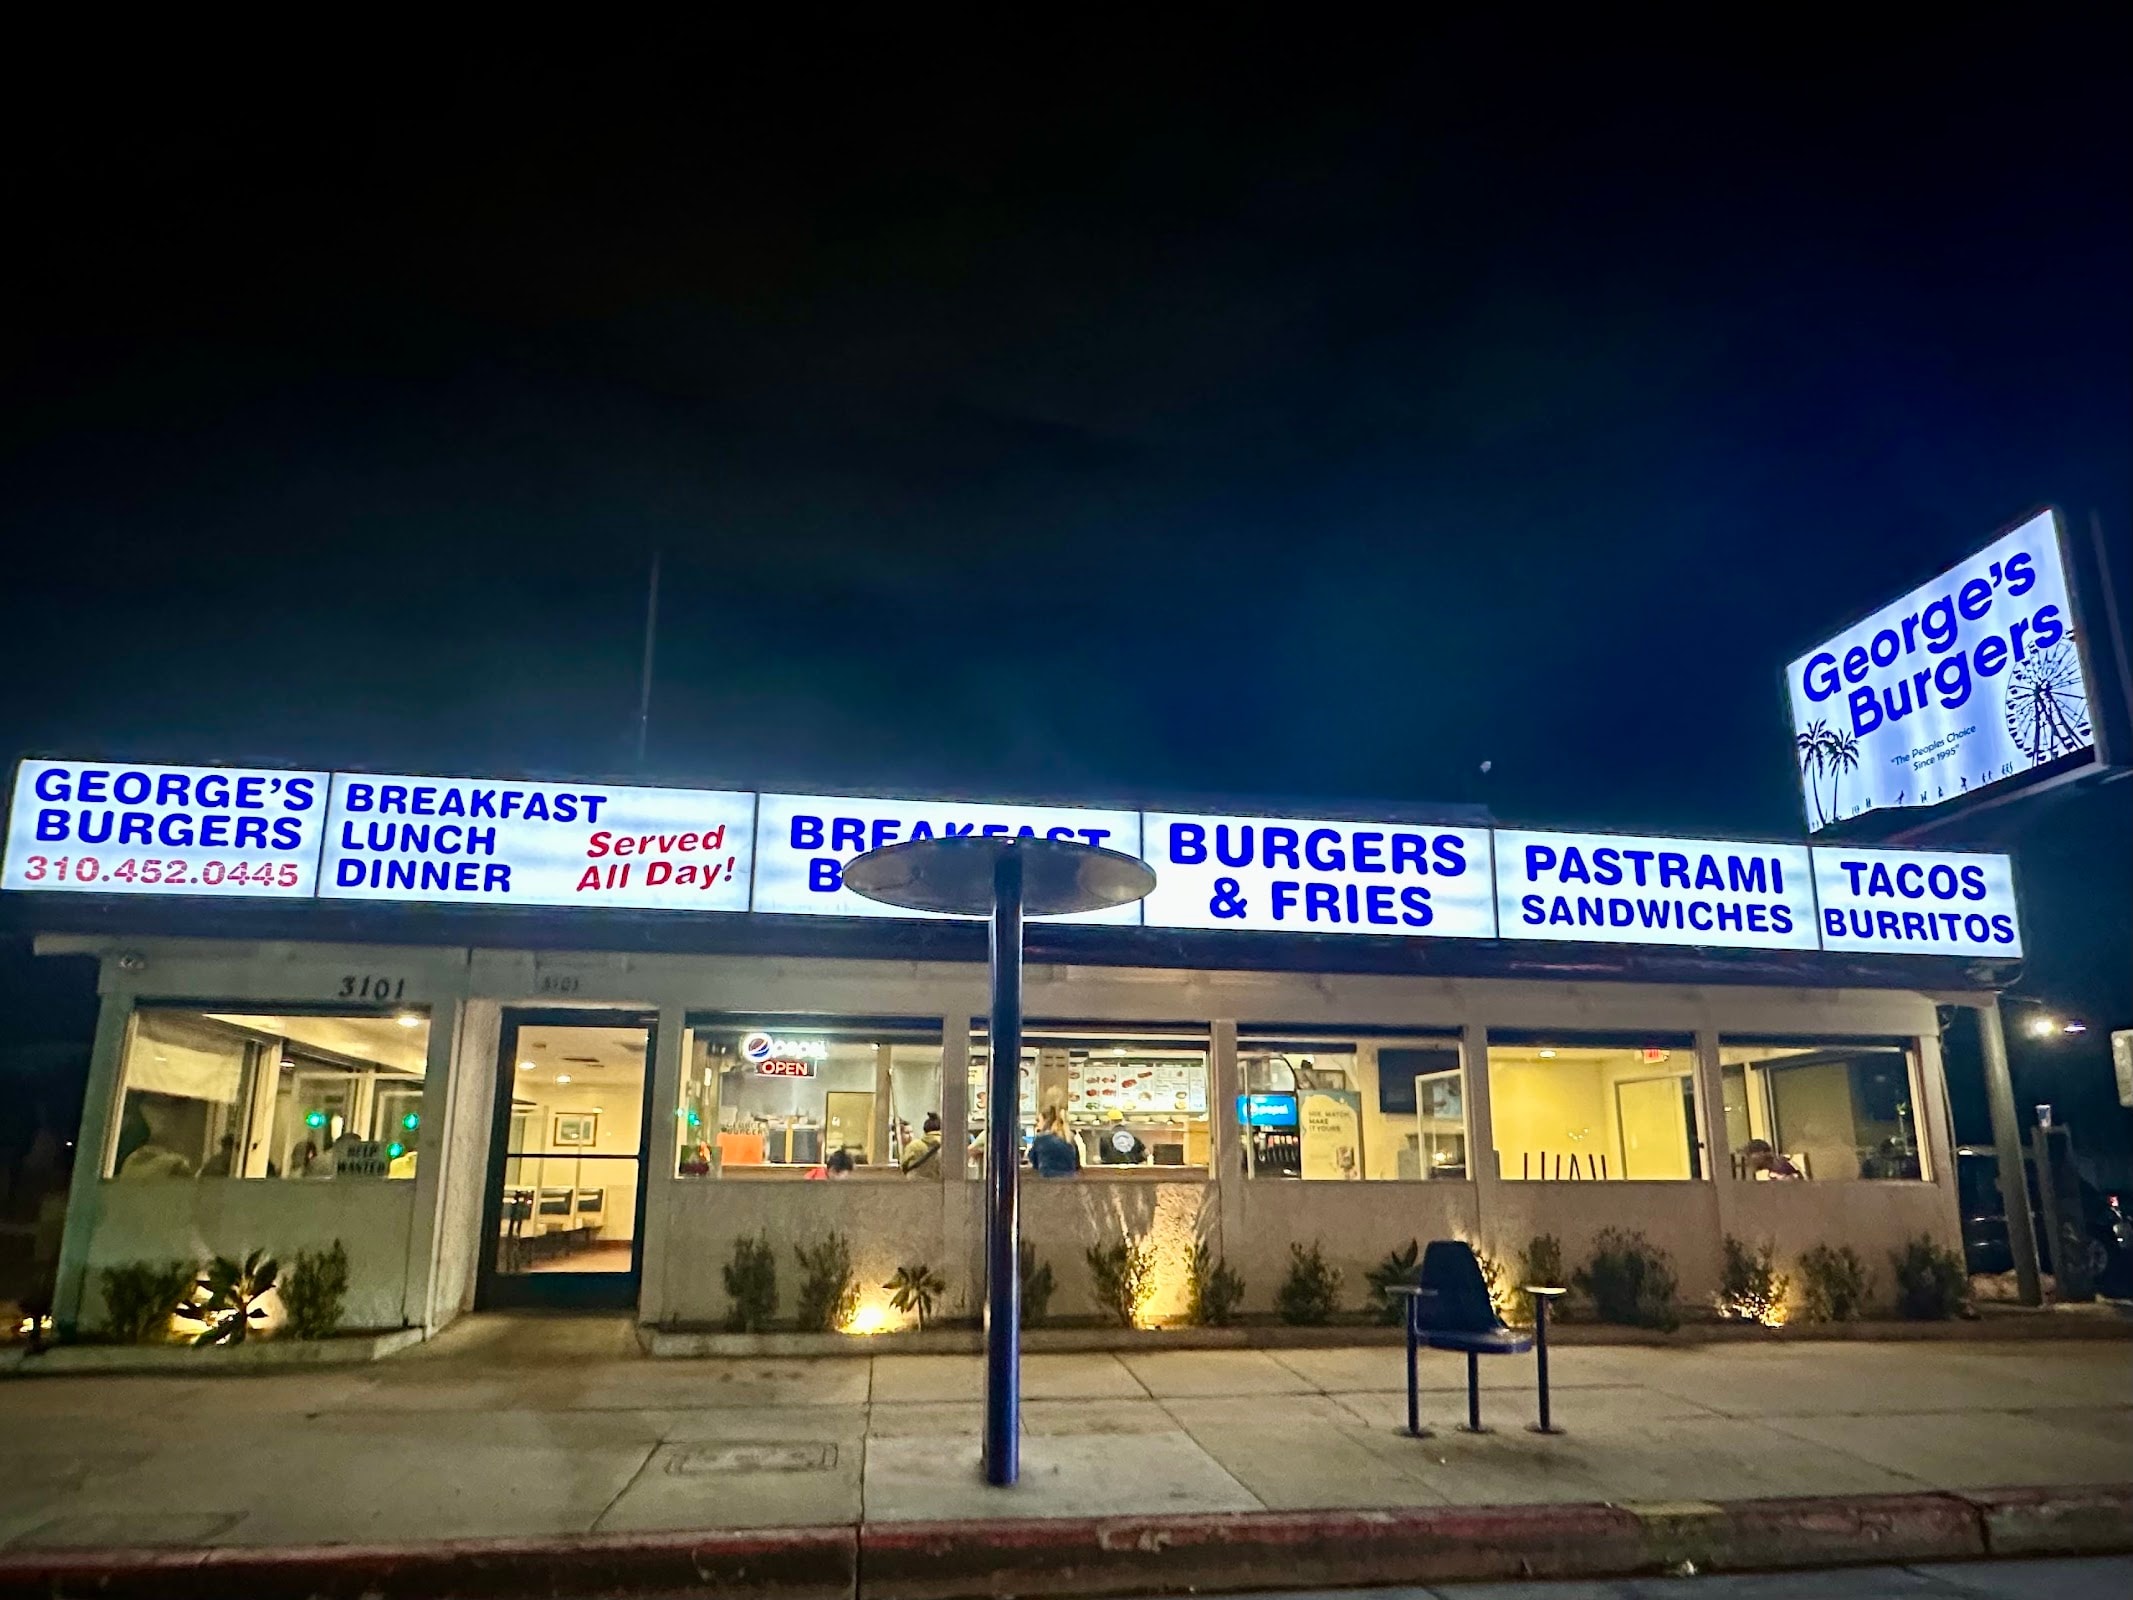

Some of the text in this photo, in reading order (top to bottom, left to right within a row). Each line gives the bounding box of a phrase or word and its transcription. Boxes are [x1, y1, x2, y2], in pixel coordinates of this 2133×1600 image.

[1804, 552, 2036, 702] George's
[1848, 604, 2063, 739] Burgers
[1911, 739, 1945, 758] Peoples
[1946, 725, 1976, 743] Choice
[1913, 757, 1935, 771] Since
[35, 768, 314, 811] GEORGE'S
[345, 783, 607, 824] BREAKFAST
[36, 808, 302, 850] BURGERS
[341, 820, 496, 856] LUNCH
[587, 825, 726, 858] Served
[1169, 822, 1467, 877] BURGERS
[1525, 844, 1784, 893] PASTRAMI
[25, 855, 298, 887] 310.452.0445
[336, 858, 511, 893] DINNER
[576, 857, 736, 892] All Day!
[1841, 861, 1987, 901] TACOS
[1209, 877, 1434, 927] & FRIES
[1521, 894, 1793, 934] SANDWICHES
[1824, 908, 2015, 944] BURRITOS
[338, 974, 405, 999] 3101
[761, 1060, 808, 1075] OPEN
